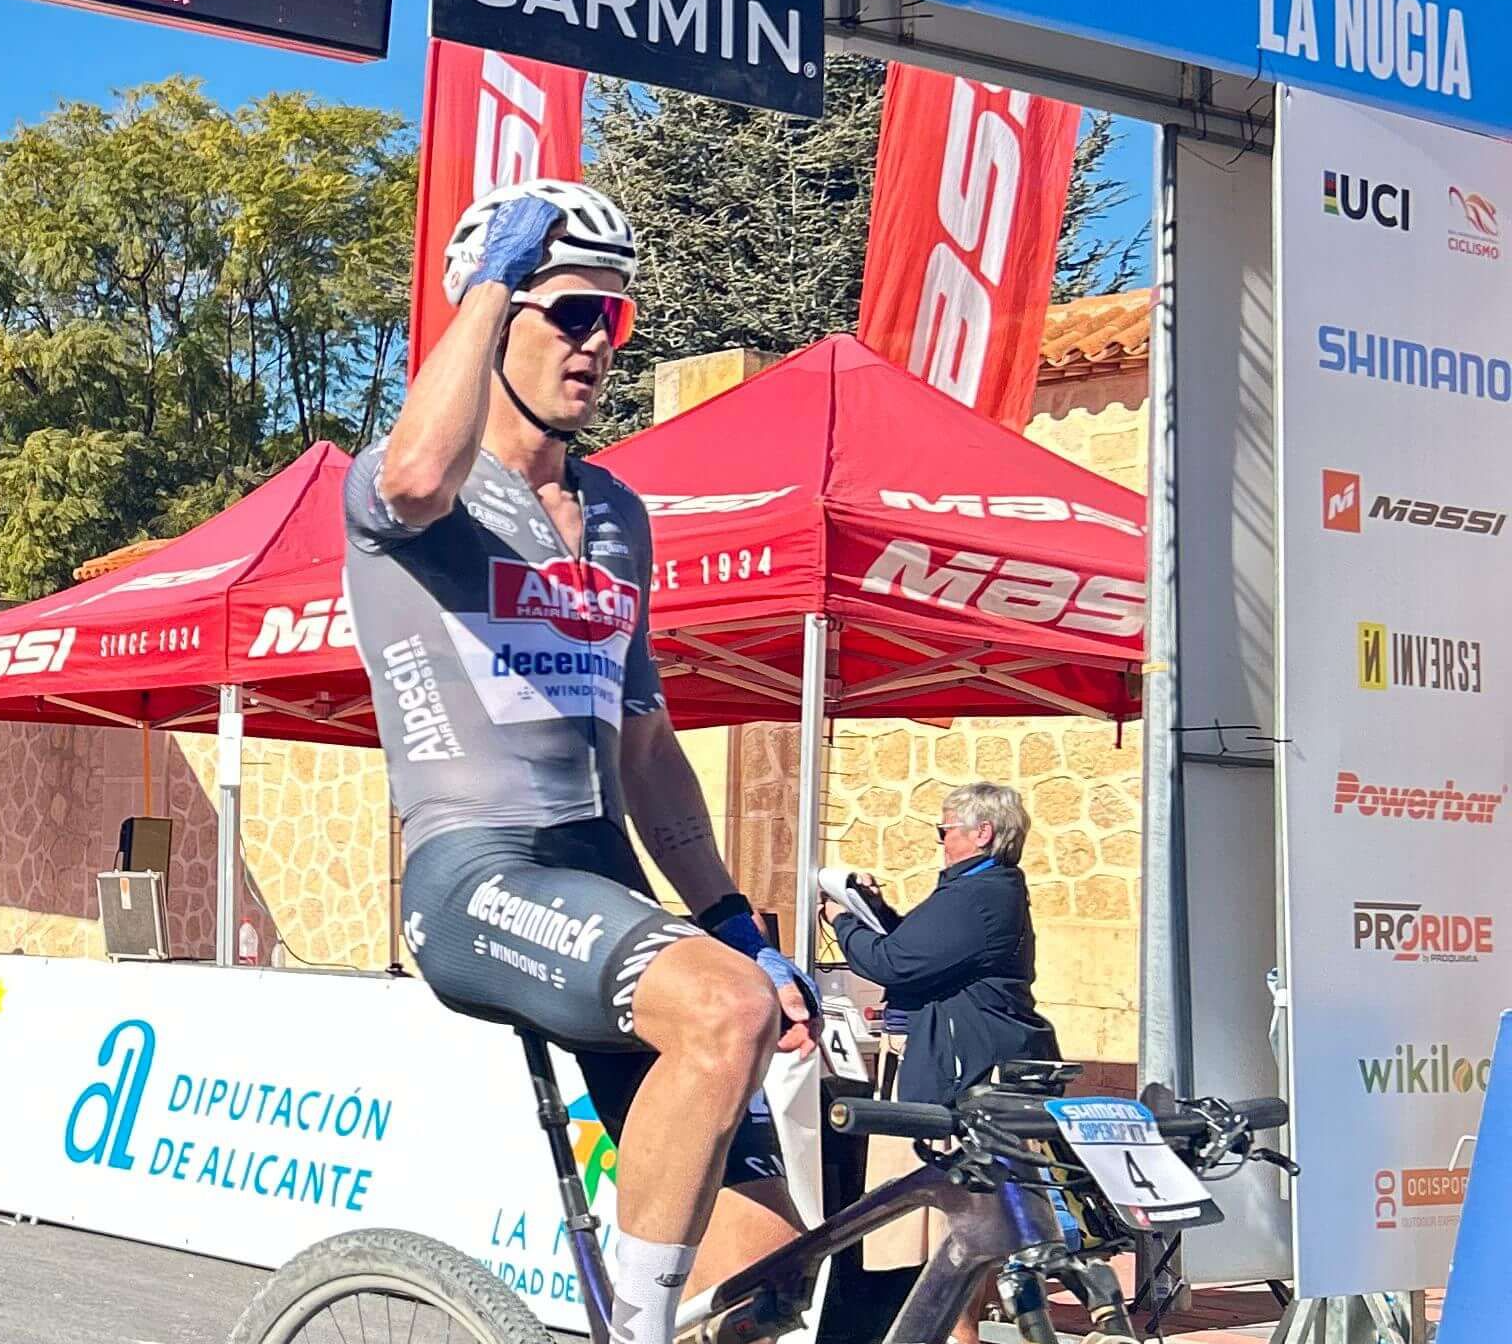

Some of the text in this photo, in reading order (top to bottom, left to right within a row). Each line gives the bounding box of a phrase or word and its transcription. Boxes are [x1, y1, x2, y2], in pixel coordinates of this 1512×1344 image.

[1340, 174, 1410, 232] UCI
[1318, 325, 1511, 402] SHIMANO
[699, 546, 772, 585] 1934
[100, 633, 148, 658] SINCE
[159, 626, 202, 654] 1934
[382, 639, 451, 762] Alpecin
[1333, 771, 1503, 824] Powerbar
[467, 873, 604, 963] deceuninck
[1353, 912, 1494, 953] PRORIDE
[489, 939, 550, 983] WINDOWS
[1358, 1043, 1492, 1094] wikiloc
[167, 1074, 393, 1142] DIPUTACIÓN
[148, 1137, 373, 1212] DE ALICANTE
[1123, 1149, 1157, 1201] 4
[1375, 1169, 1397, 1229] OCI
[491, 1208, 527, 1251] LA
